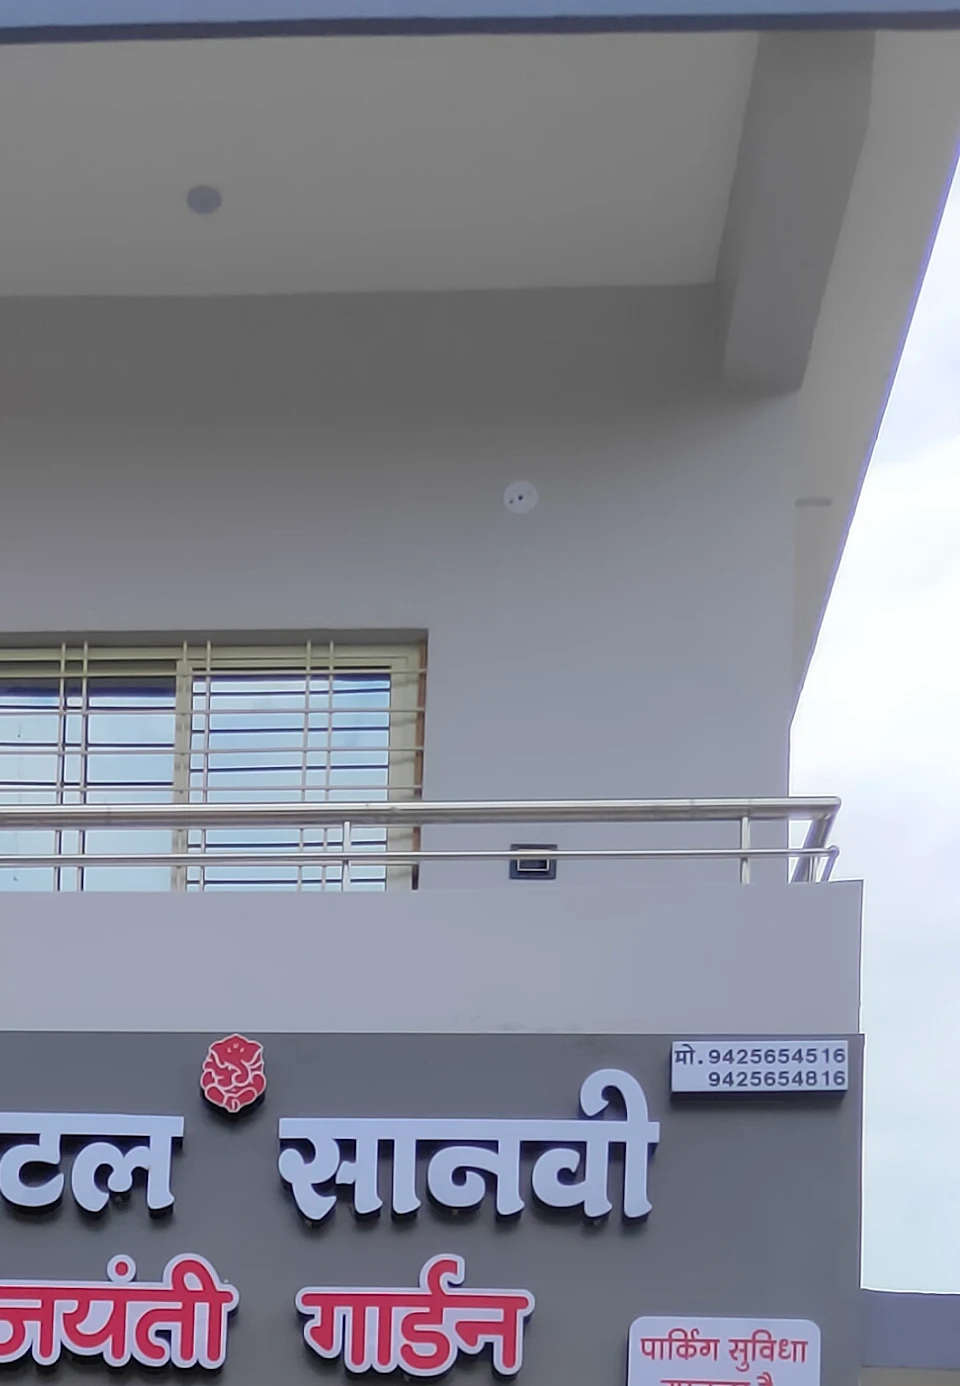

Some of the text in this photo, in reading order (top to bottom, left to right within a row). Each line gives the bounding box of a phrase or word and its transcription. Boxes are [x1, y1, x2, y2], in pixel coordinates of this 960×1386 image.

[708, 1071, 846, 1087] 9425654816
[278, 1068, 660, 1221] सानवी
[295, 1253, 535, 1377] गार्डन
[728, 1329, 808, 1372] सुविधा
